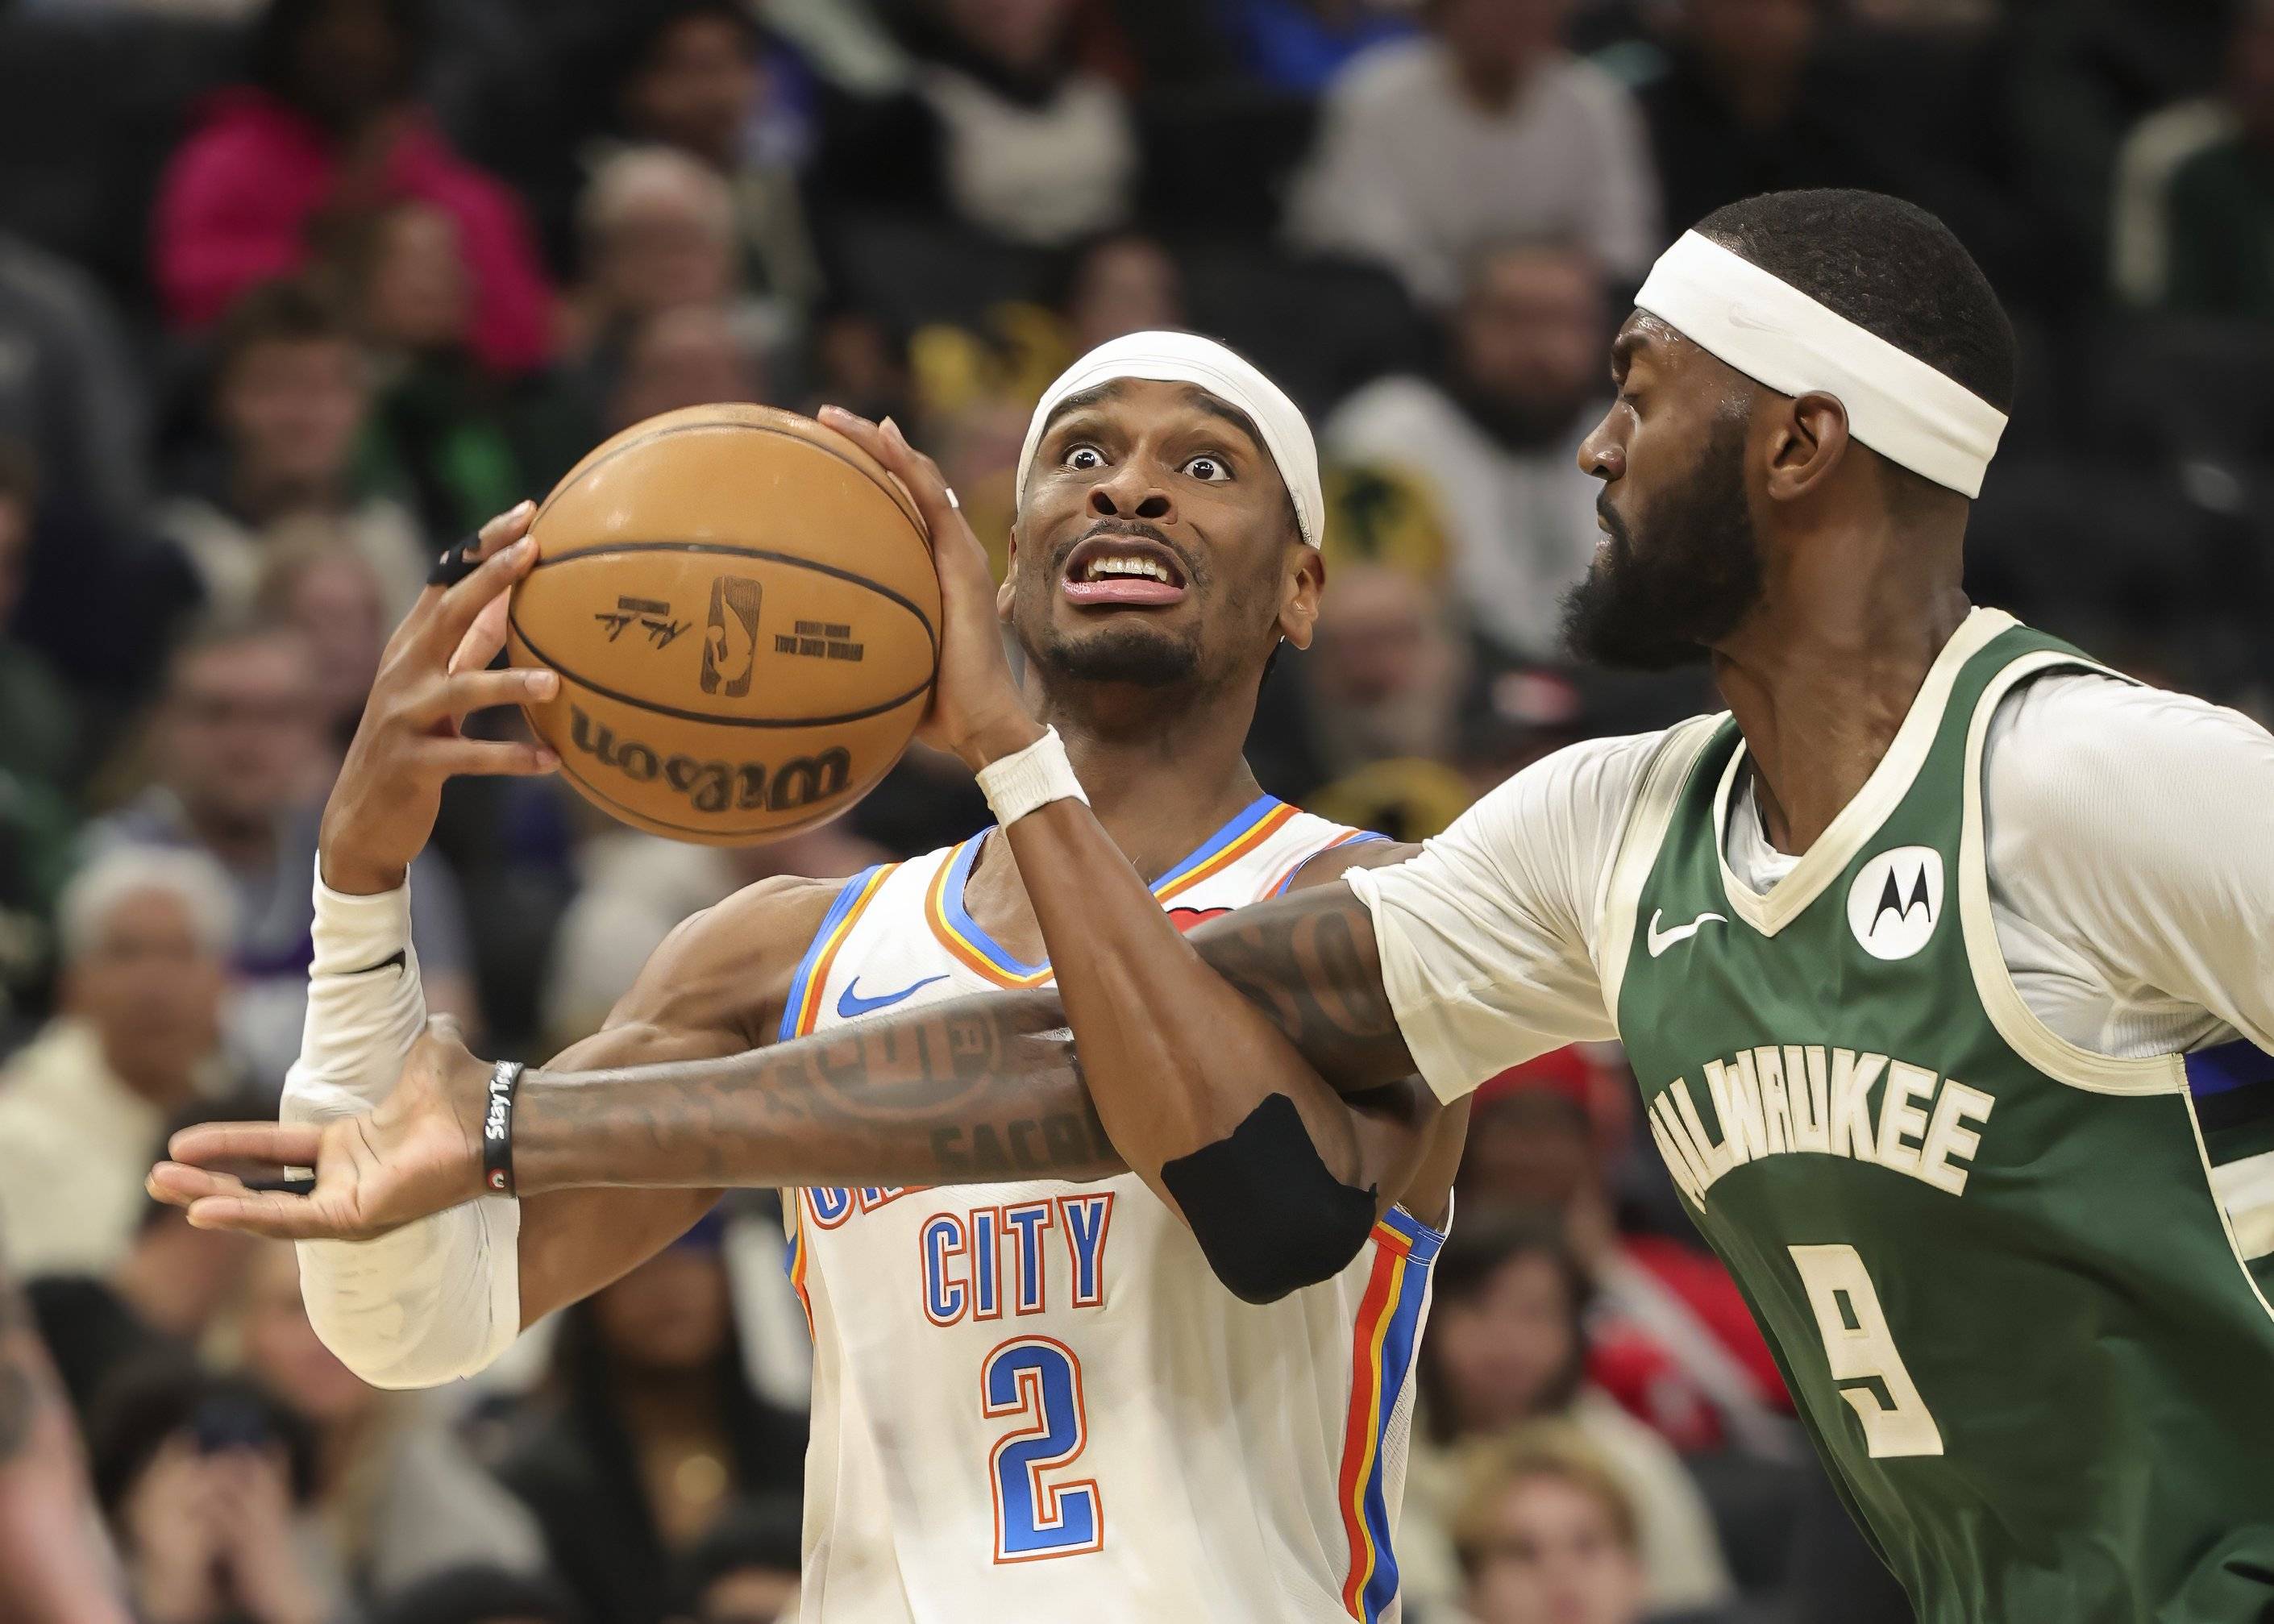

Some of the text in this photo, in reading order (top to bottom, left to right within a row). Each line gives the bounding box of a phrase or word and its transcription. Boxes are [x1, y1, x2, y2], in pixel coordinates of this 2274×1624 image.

[571, 704, 852, 812] Wilson
[919, 1191, 1115, 1327] CITY
[1786, 1244, 1944, 1459] 9
[980, 1334, 1104, 1565] 2
